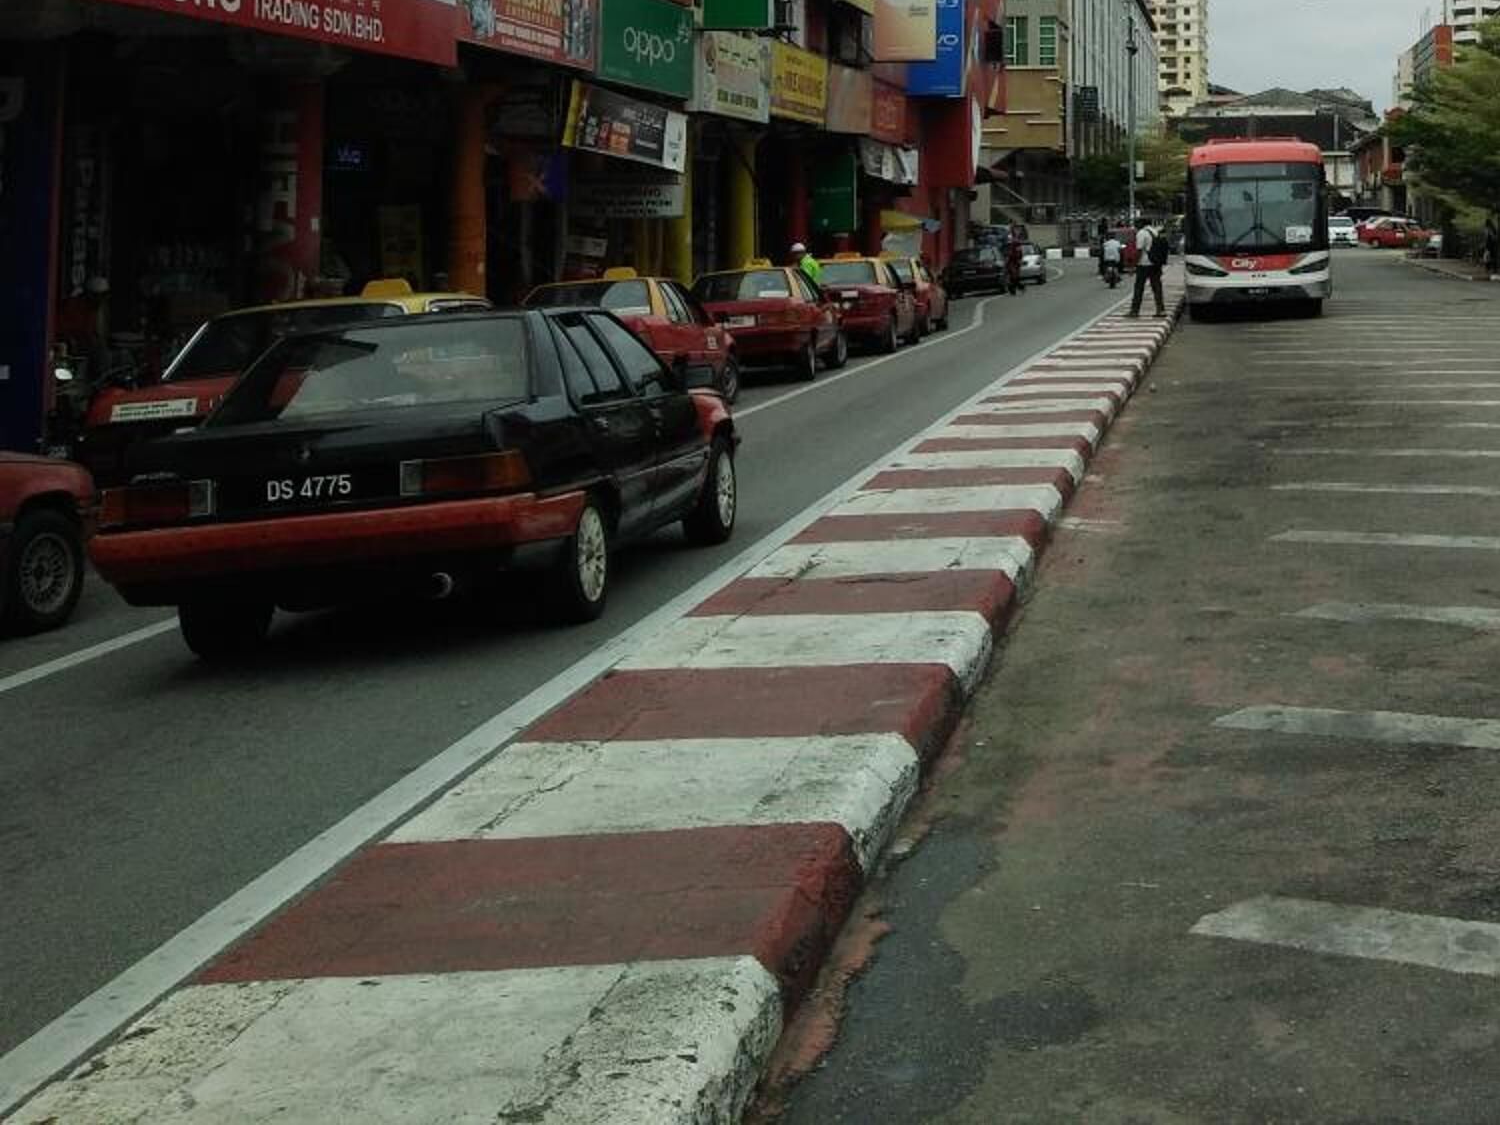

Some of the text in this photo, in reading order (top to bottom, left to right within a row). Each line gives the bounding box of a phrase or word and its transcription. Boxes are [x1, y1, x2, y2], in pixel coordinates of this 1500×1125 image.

[1231, 257, 1257, 270] City
[267, 475, 352, 502] DS 4775
